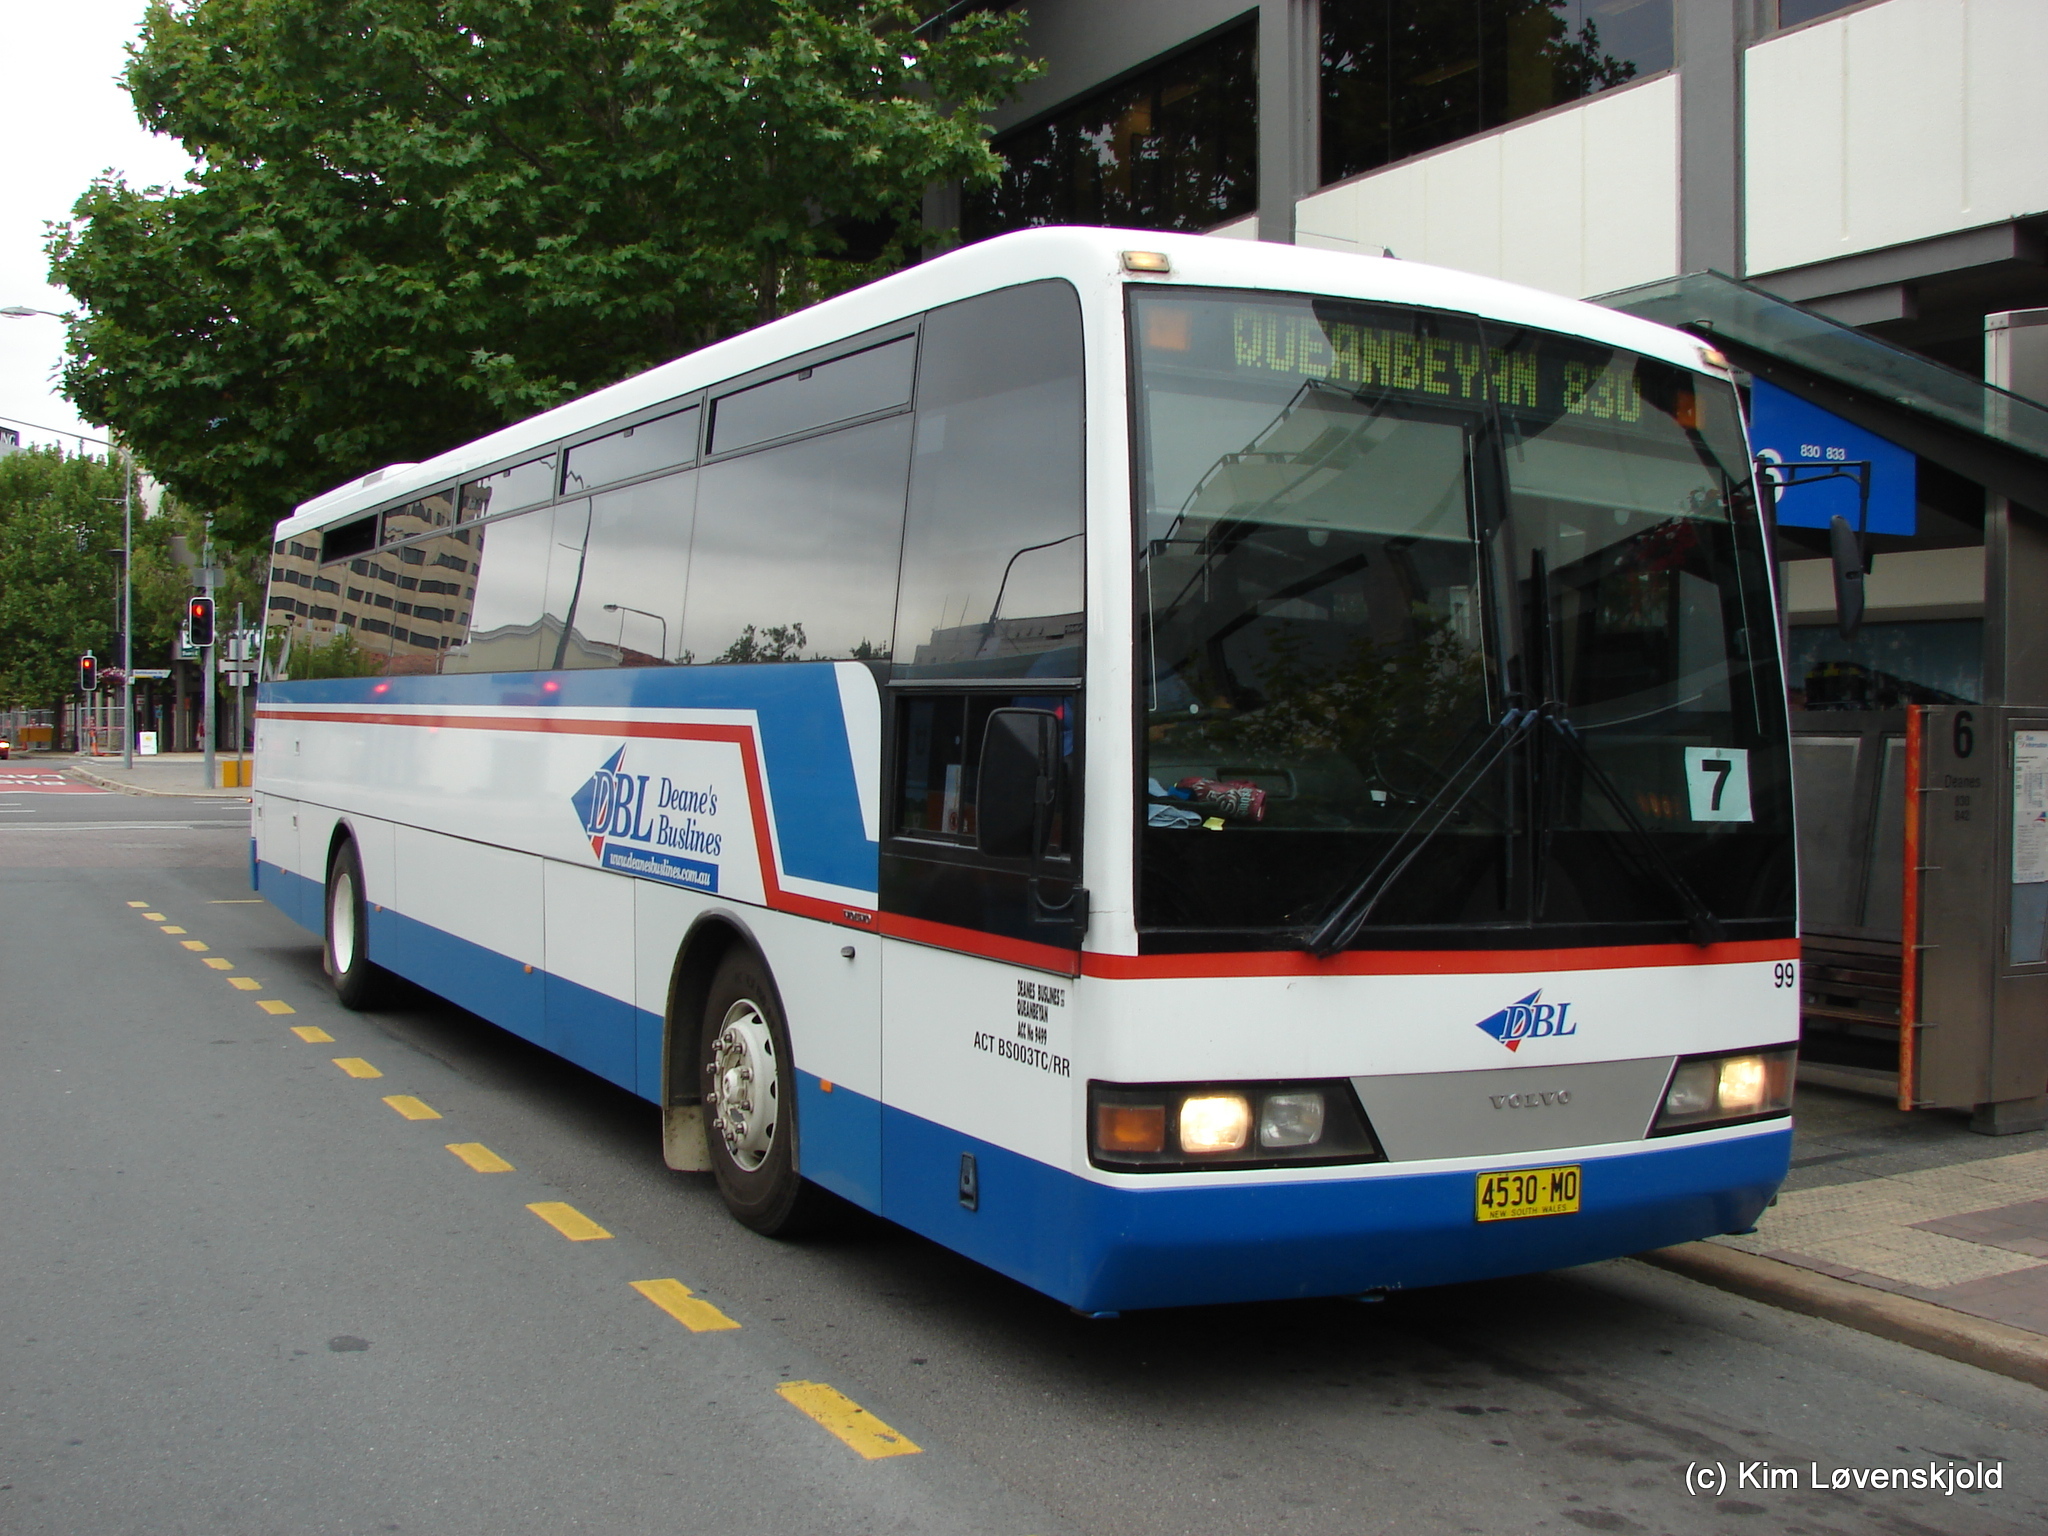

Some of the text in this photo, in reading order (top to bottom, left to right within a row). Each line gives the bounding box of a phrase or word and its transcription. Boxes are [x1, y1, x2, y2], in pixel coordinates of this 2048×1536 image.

[1233, 309, 1641, 423] QUEANBEYAN 830
[1800, 444, 1845, 460] 830 833
[1953, 710, 1973, 758] 6
[657, 777, 718, 816] Deane's
[1701, 759, 1731, 811] 7
[1944, 774, 1981, 788] Deanes
[587, 770, 654, 842] DBL
[656, 814, 722, 856] Buslines
[610, 852, 711, 886] www.deanesbuslines.com.au
[1017, 979, 1035, 1000] DEANES
[1774, 963, 1795, 988] 99
[1499, 1003, 1577, 1041] DBL
[973, 1031, 1070, 1078] ACT BS003TC/RR
[1489, 1090, 1572, 1110] VOLVO
[1489, 1203, 1567, 1219] NEW SOUTH WALES
